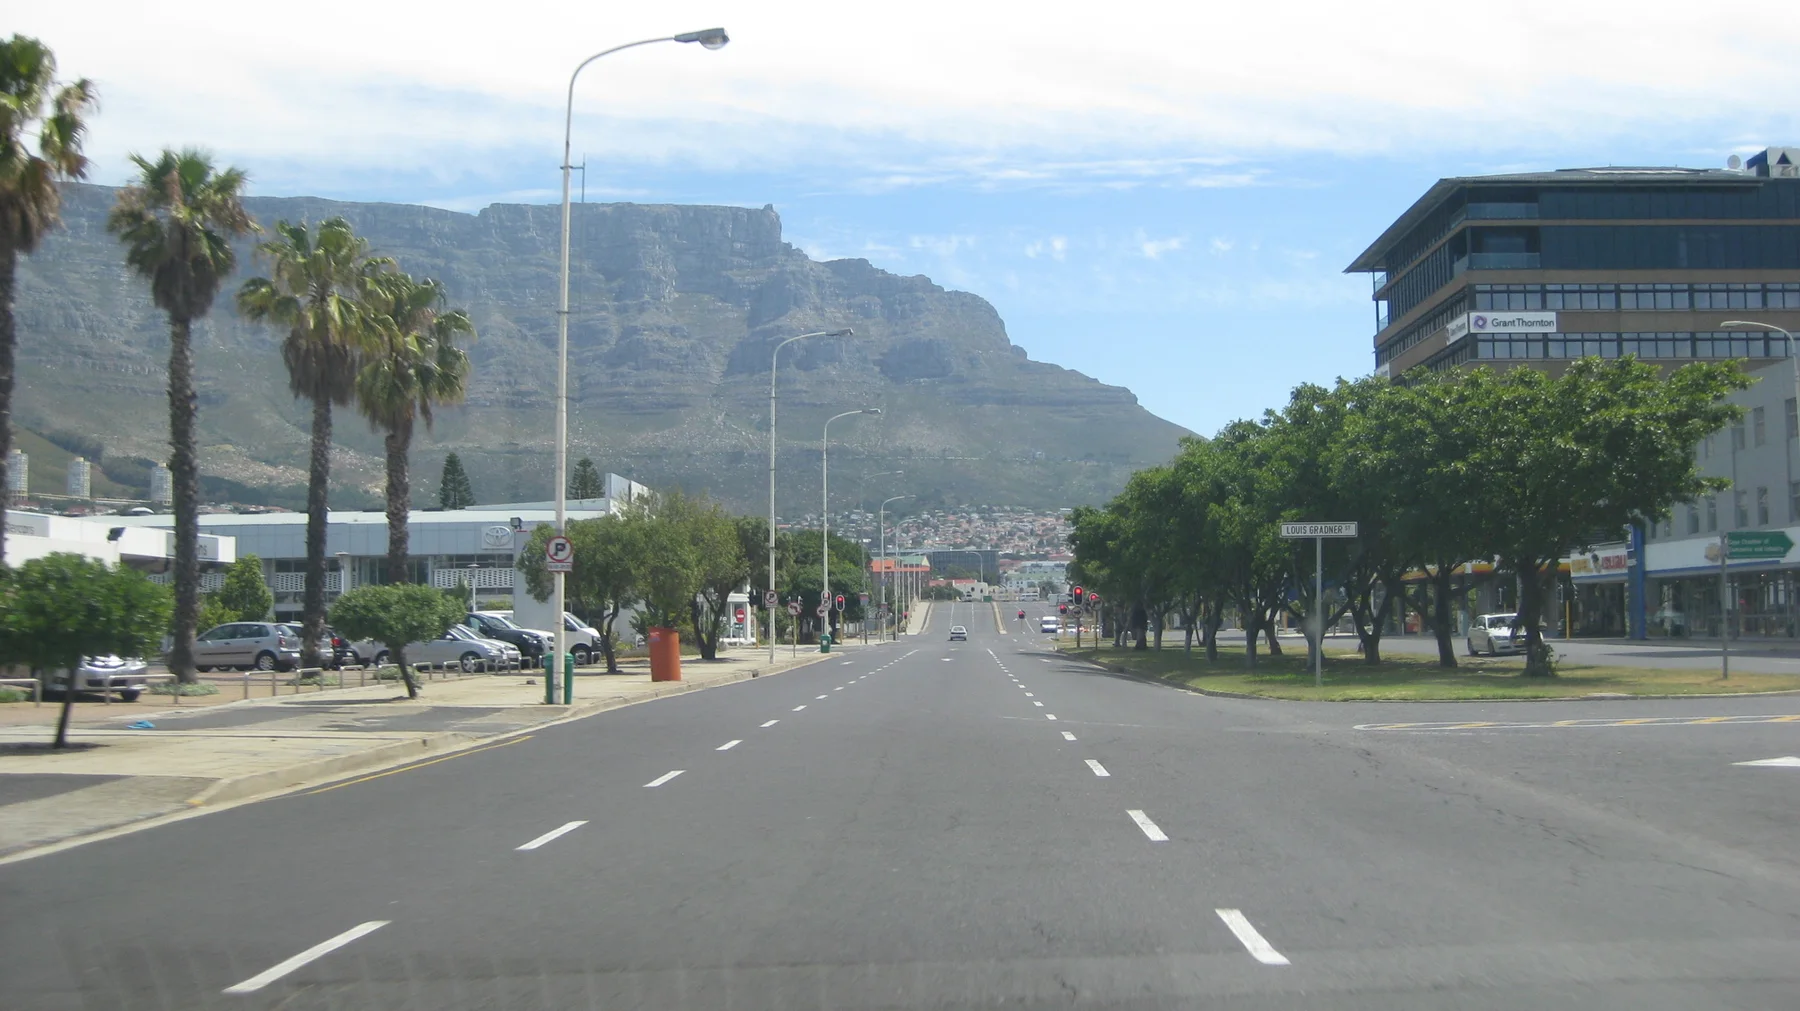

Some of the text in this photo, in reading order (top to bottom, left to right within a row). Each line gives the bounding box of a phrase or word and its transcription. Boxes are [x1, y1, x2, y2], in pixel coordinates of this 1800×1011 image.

[1491, 317, 1555, 327] Grant Thornton
[1286, 525, 1307, 535] LOUIS
[1309, 525, 1343, 535] GRADNER
